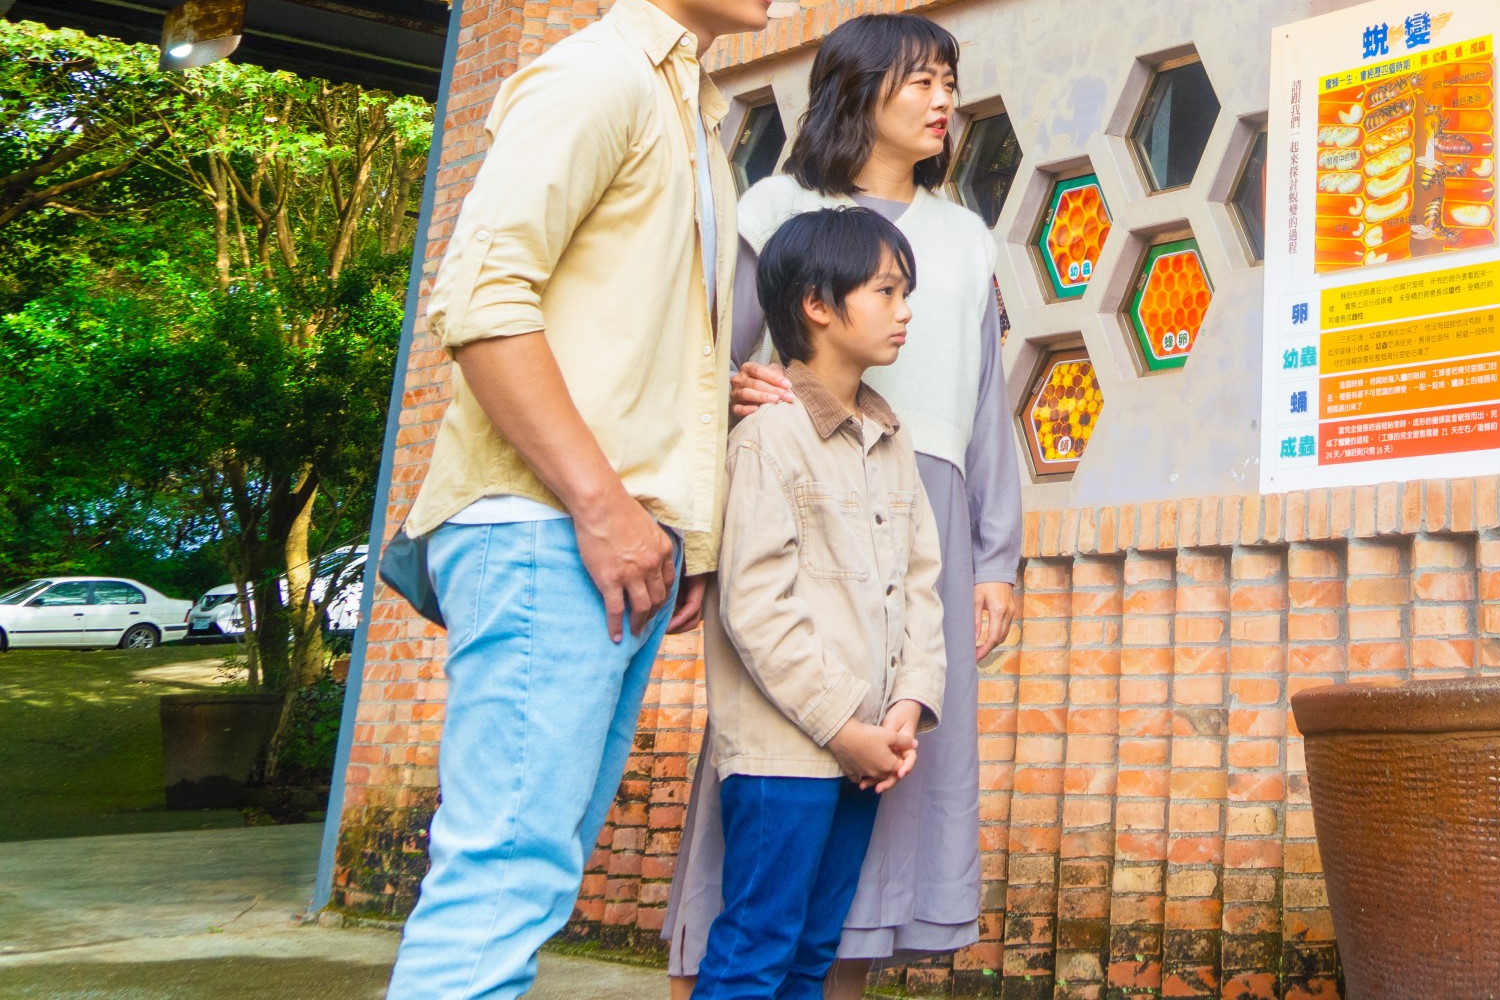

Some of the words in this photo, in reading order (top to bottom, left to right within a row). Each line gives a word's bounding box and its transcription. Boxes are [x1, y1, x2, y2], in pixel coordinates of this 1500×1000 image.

[1362, 11, 1432, 59] 蛻變
[1070, 262, 1090, 277] 幼蟲
[1292, 302, 1308, 325] 卵
[1165, 332, 1188, 348] 蜂卵
[1282, 345, 1317, 370] 幼蟲
[1290, 390, 1307, 413] 蛹
[1060, 440, 1069, 453] 蛹
[1280, 435, 1316, 459] 成蟲
